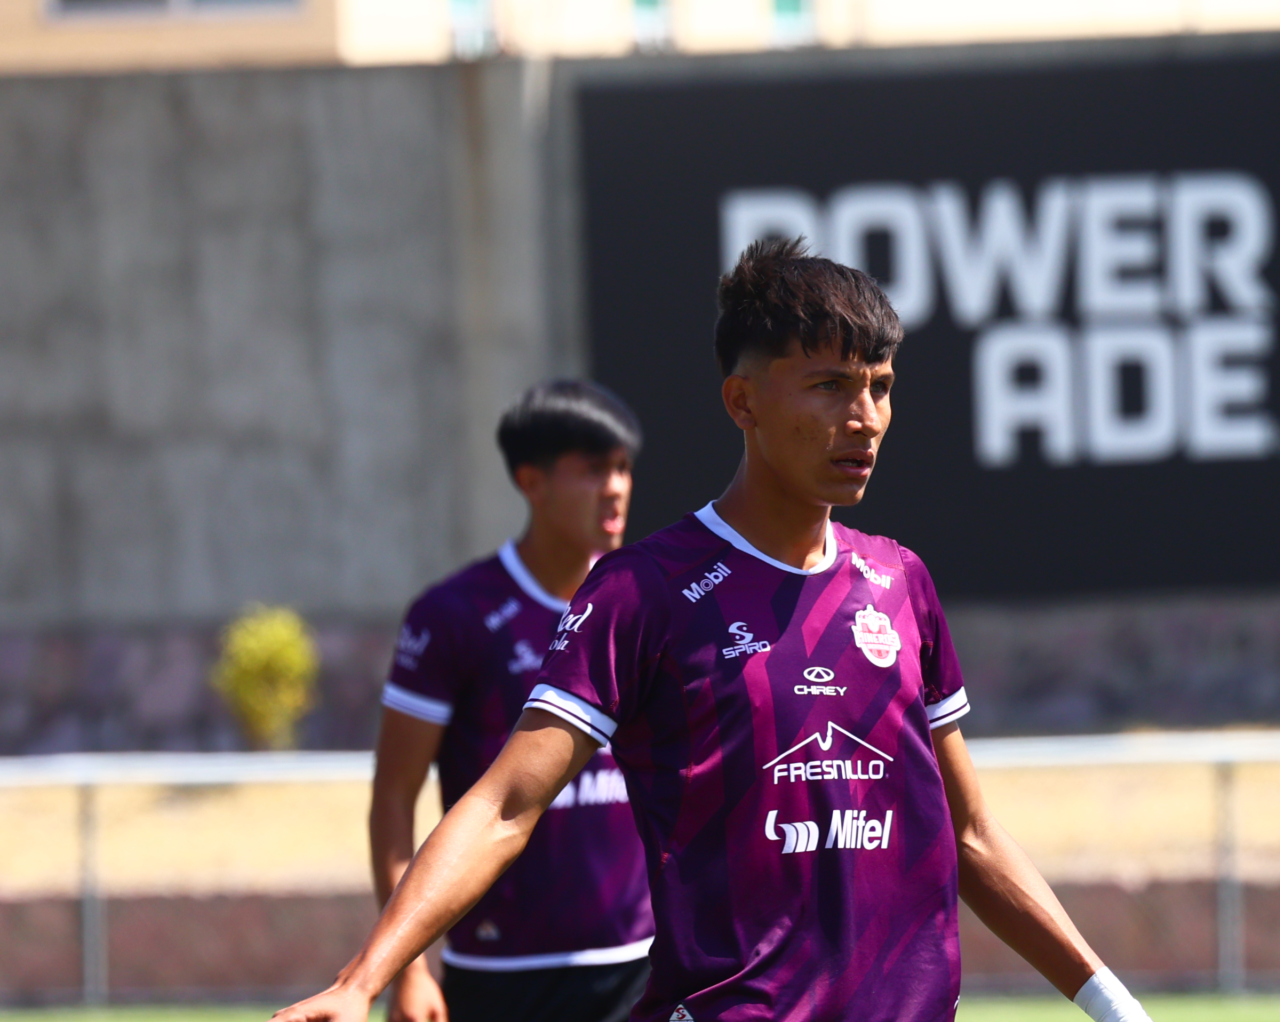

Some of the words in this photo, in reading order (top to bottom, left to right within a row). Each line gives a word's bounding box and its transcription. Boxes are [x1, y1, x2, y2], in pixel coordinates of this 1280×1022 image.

[974, 319, 1275, 467] ADE
[682, 561, 732, 603] Mobil
[851, 551, 892, 590] Mobil
[722, 641, 771, 659] SPIRO
[793, 685, 848, 696] CHIREY
[773, 759, 885, 785] FRESNILLO
[825, 809, 893, 850] Mifel
